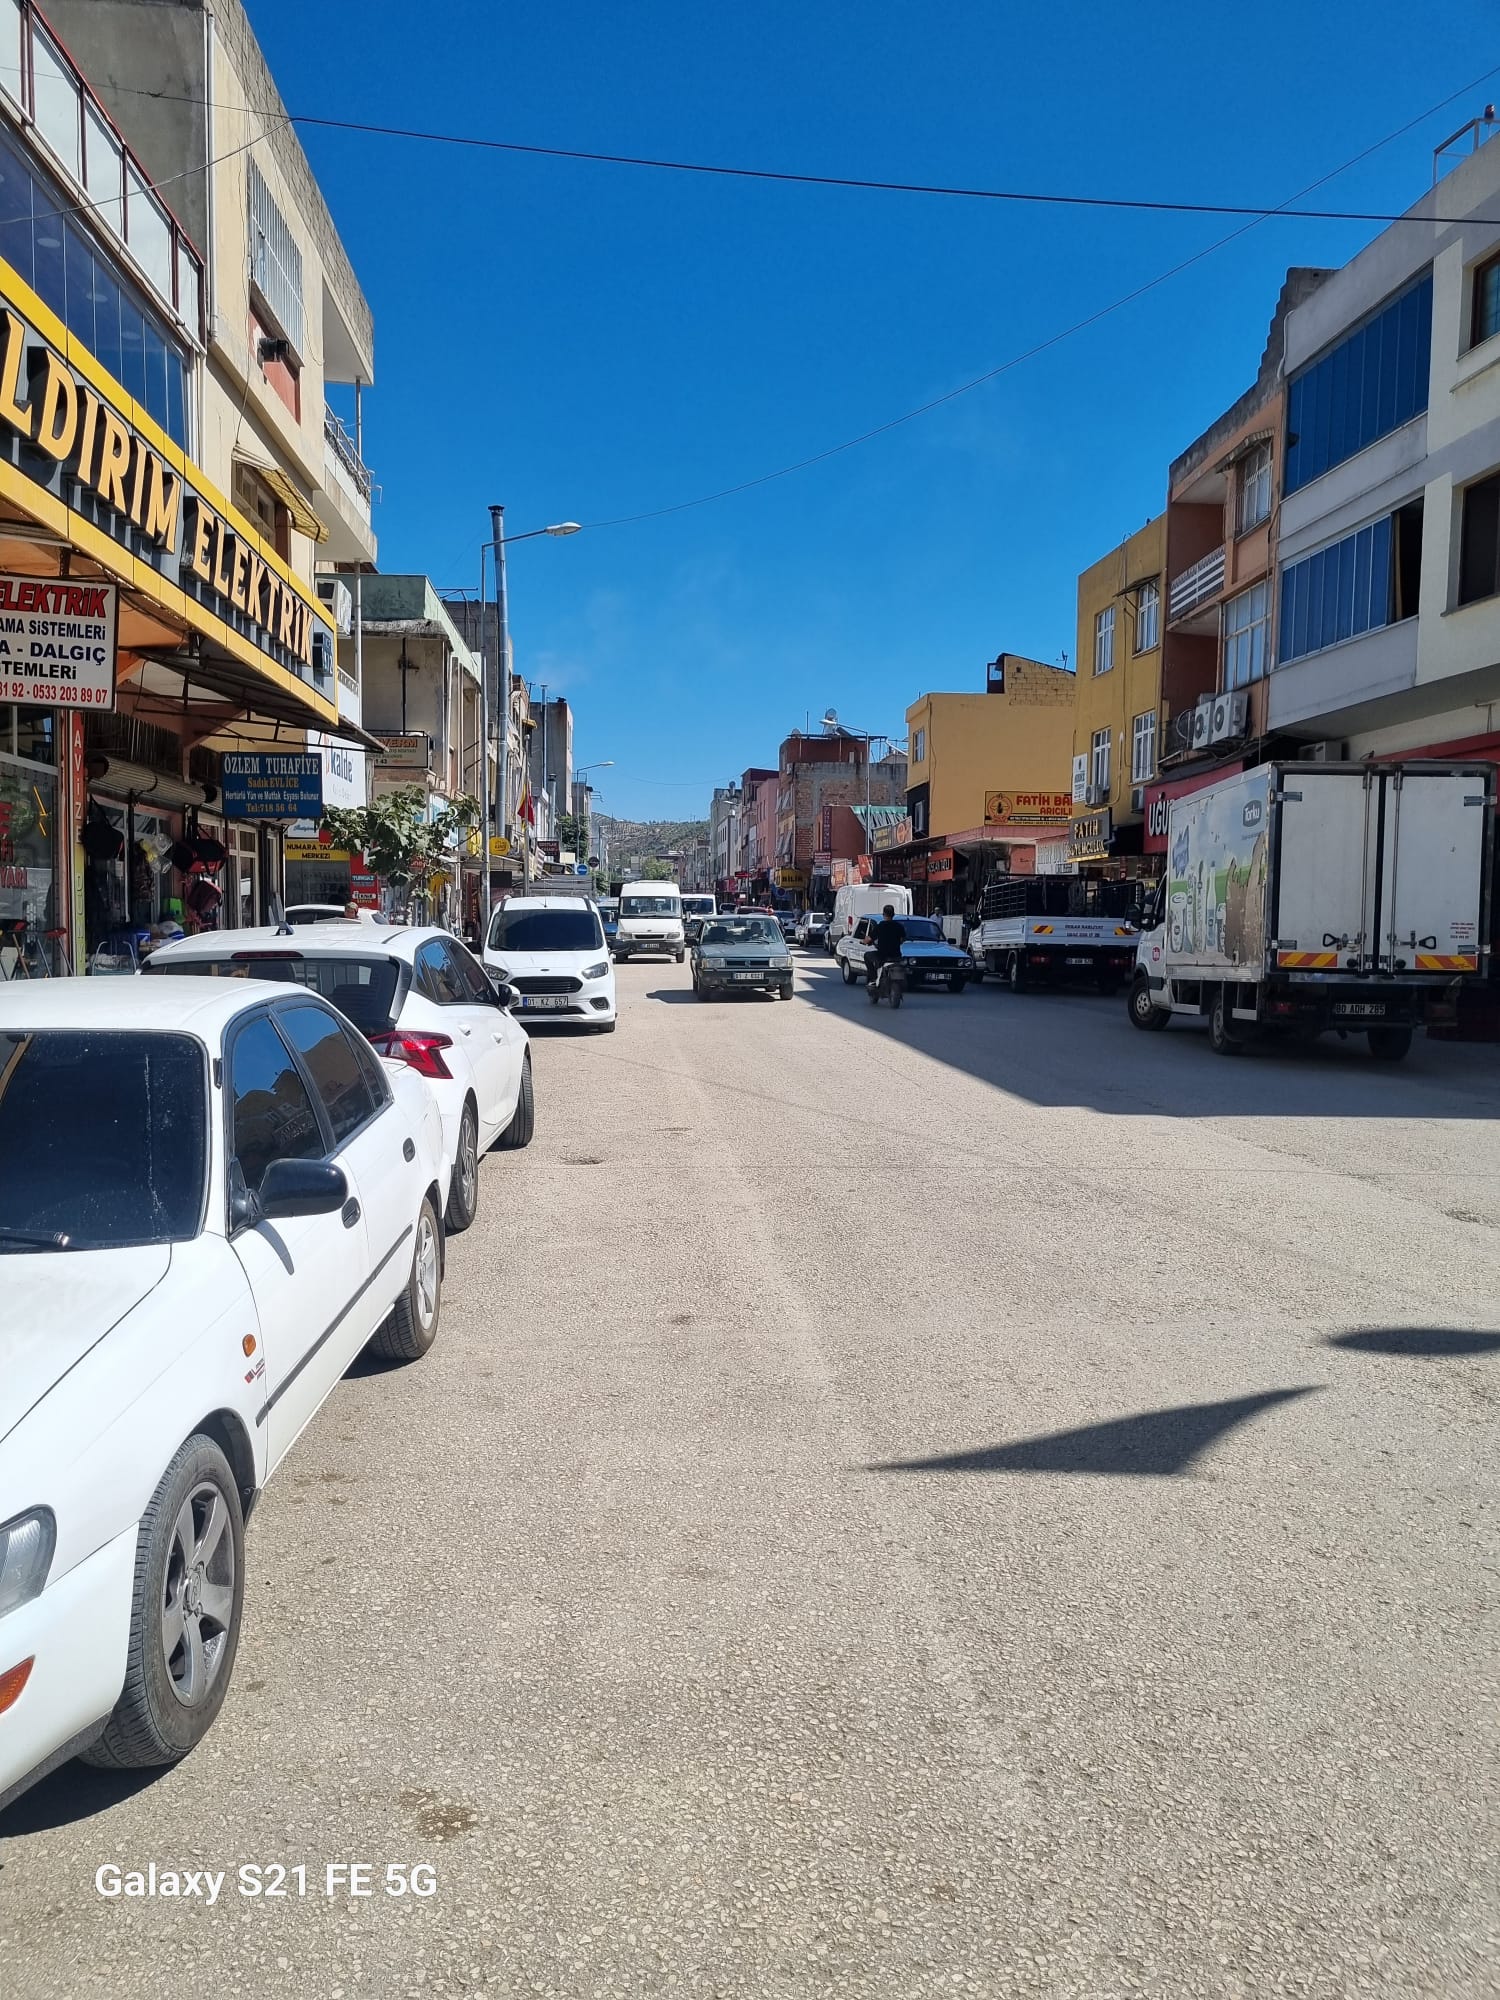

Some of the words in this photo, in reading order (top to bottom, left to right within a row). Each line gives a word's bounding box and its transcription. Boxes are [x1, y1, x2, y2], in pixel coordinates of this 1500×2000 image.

[30, 642, 106, 665] DALGIÇ
[33, 684, 57, 699] 0533
[60, 686, 77, 701] 203
[80, 687, 92, 702] 89
[95, 689, 108, 703] 07
[224, 753, 260, 774] ÖZLEM
[266, 754, 319, 775] TUHAFİYE
[1016, 793, 1050, 806] FATİH
[286, 843, 317, 851] NUMARA
